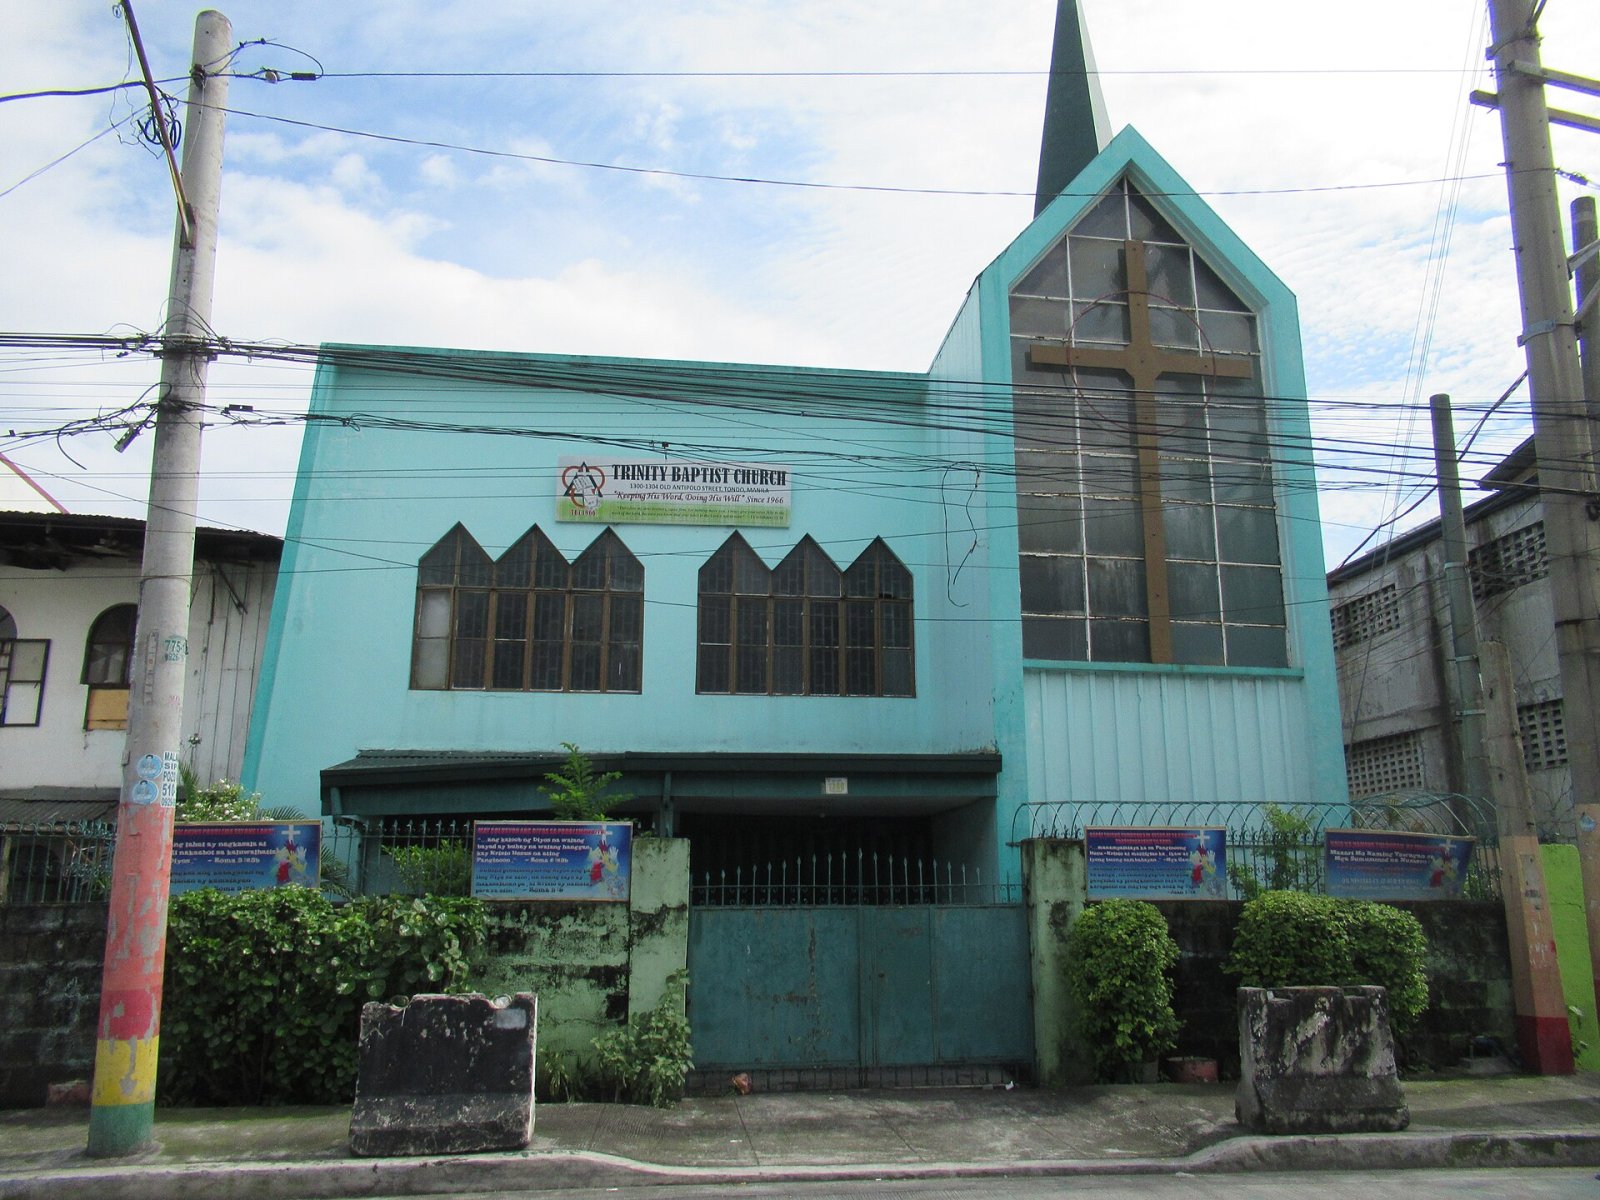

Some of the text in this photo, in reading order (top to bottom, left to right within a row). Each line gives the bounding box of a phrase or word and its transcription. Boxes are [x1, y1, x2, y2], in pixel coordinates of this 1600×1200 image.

[612, 465, 787, 486] TRINITY BAPTIST CHURCH
[647, 492, 661, 500] His
[661, 492, 684, 502] Word,
[685, 494, 707, 503] Doing
[708, 494, 721, 502] His
[746, 496, 765, 504] Since
[766, 496, 784, 504] 1966
[1367, 850, 1393, 858] Kaming
